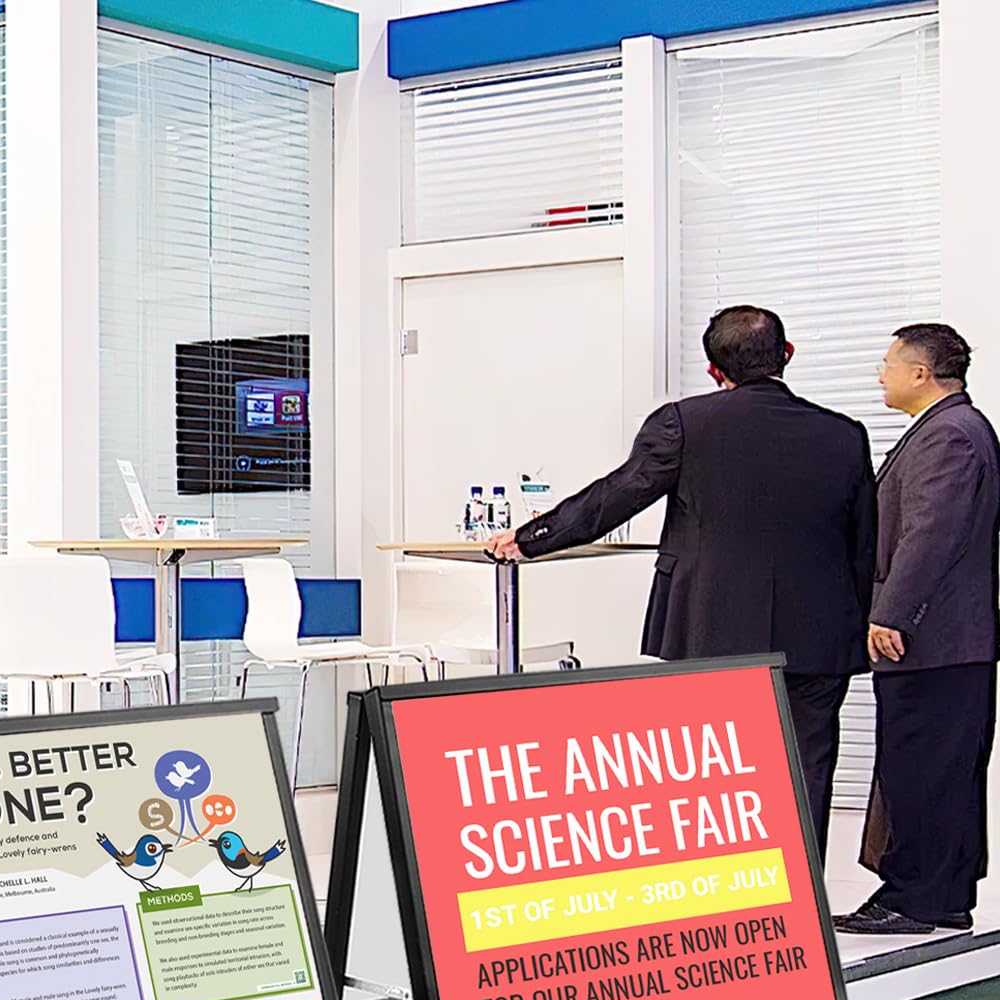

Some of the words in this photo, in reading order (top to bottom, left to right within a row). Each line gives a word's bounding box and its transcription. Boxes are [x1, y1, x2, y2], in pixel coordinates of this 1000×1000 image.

[8, 741, 137, 778] BETTER
[444, 741, 548, 807] THE
[565, 720, 756, 795] ANNUAL
[5, 834, 40, 845] defence
[40, 831, 59, 841] and
[26, 843, 78, 856] fairy-wrens
[460, 802, 661, 879] SCIENCE
[668, 790, 769, 851] FAIR
[147, 891, 194, 906] METHODS
[470, 903, 517, 930] 1ST
[523, 897, 555, 922] OF
[562, 889, 617, 917] JULY
[639, 879, 687, 905] 3RD
[691, 874, 721, 897] OF
[727, 865, 777, 891] JULY
[478, 940, 631, 990] APPLICATIONS
[637, 932, 677, 963] ARE
[679, 924, 727, 955] NOW
[734, 915, 787, 946] OPEN
[674, 953, 760, 991] SCIENCE
[763, 946, 808, 976] FAIR
